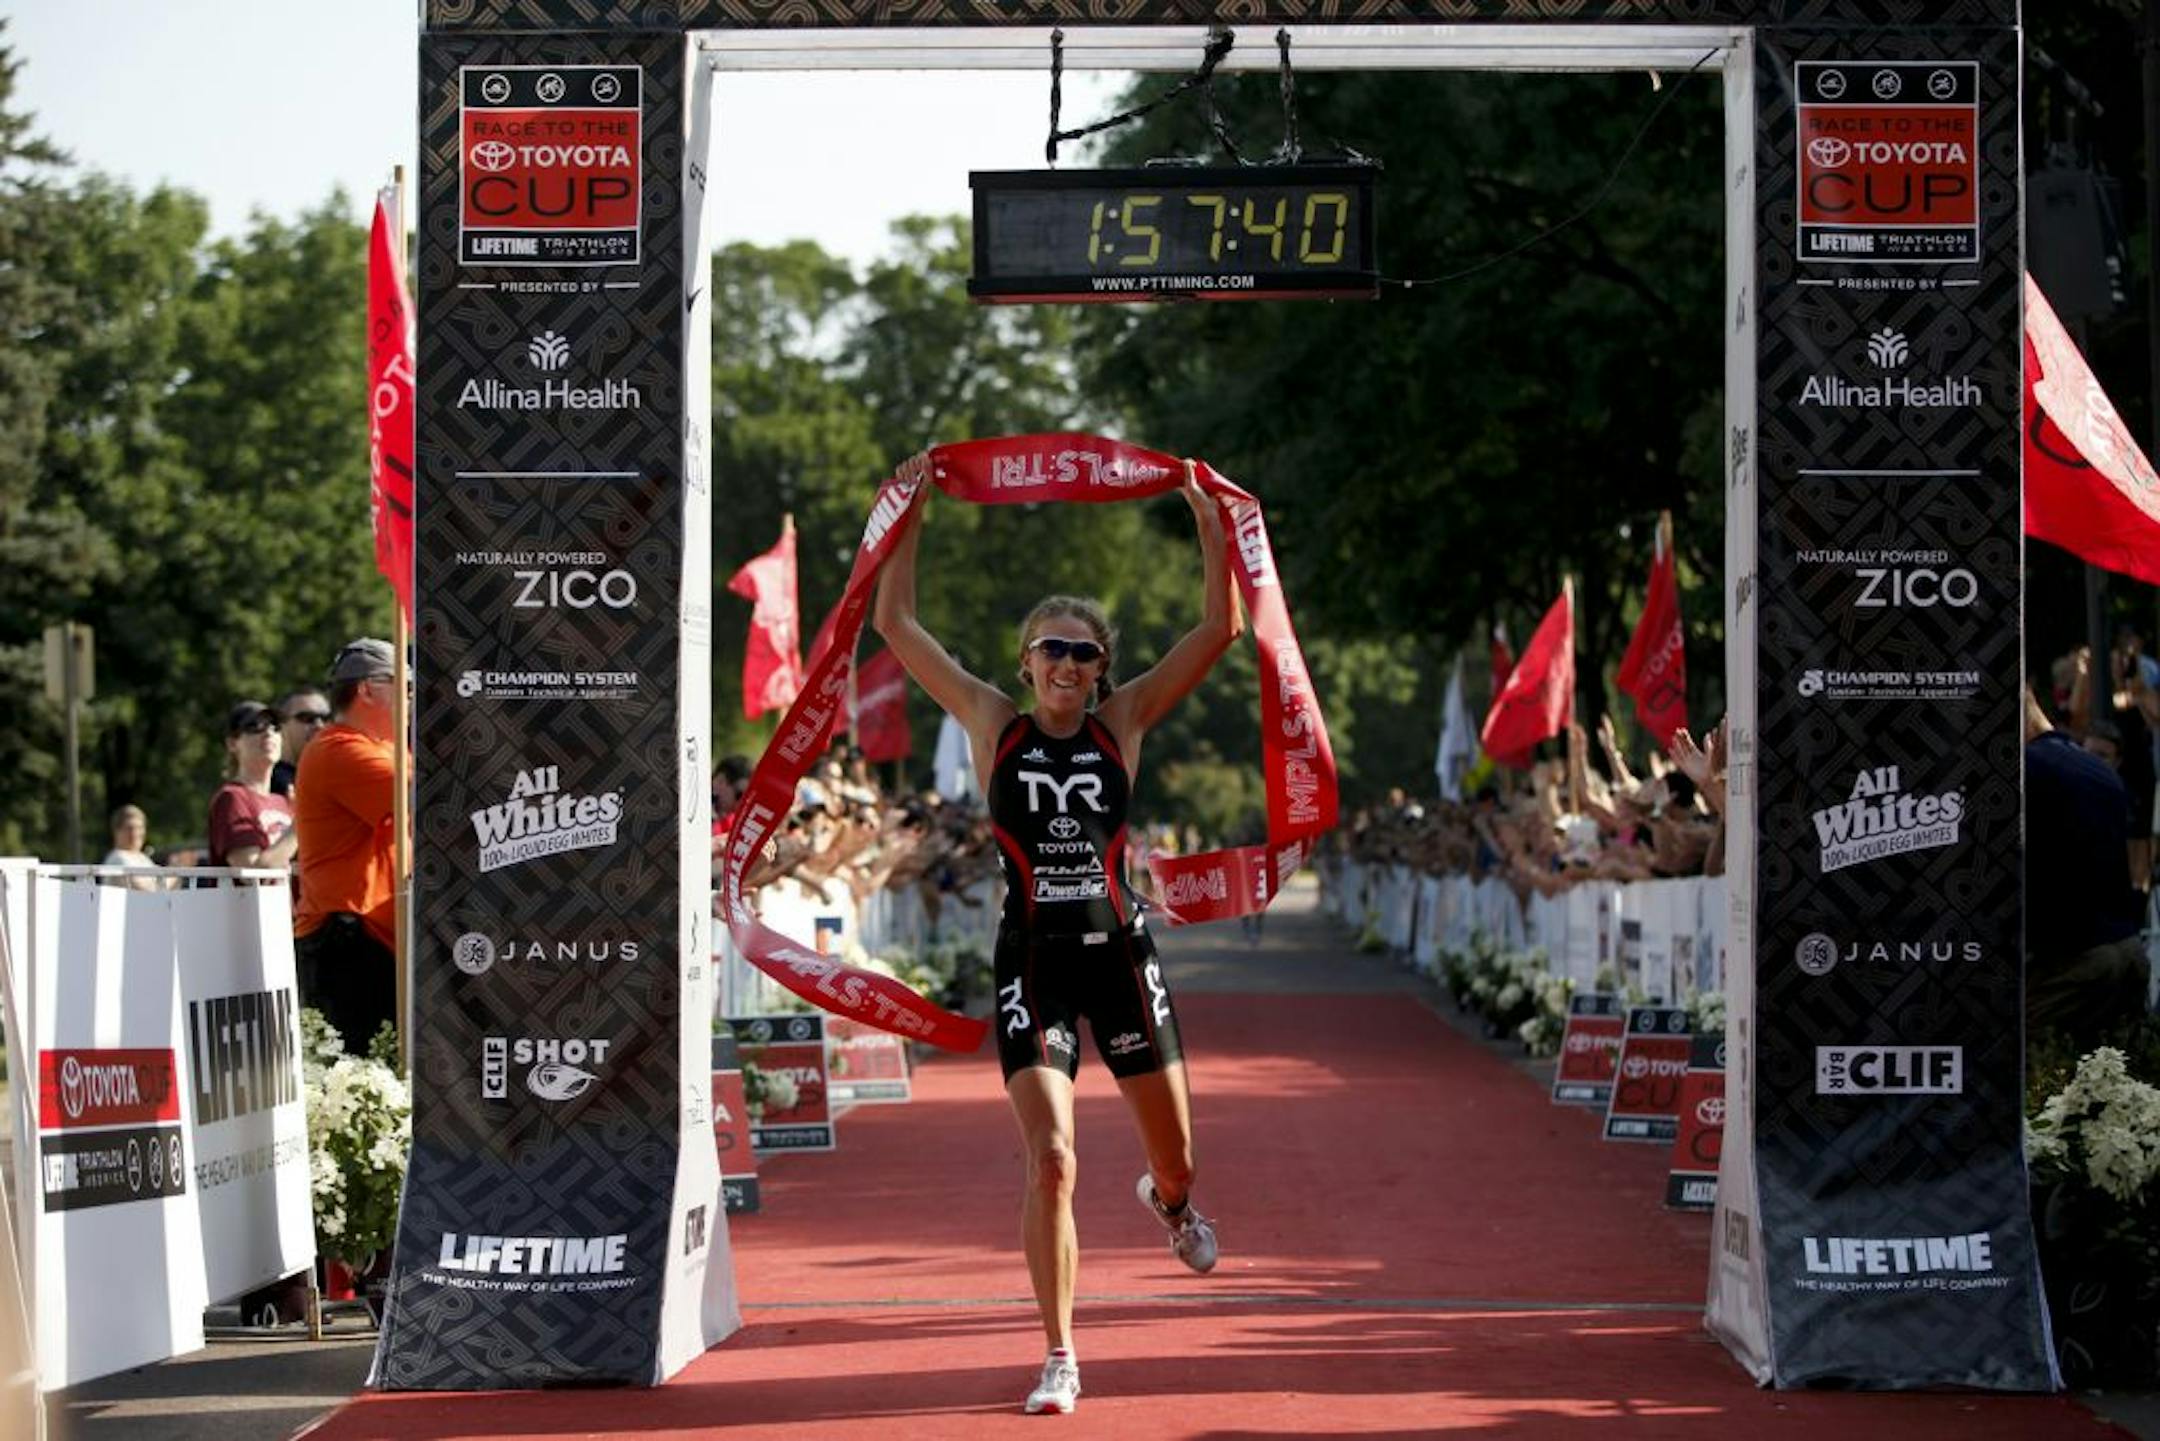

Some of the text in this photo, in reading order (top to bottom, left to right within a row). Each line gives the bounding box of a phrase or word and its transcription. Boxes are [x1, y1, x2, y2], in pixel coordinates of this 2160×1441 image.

[473, 120, 630, 136] RACE TO THE
[1809, 118, 1967, 132] RACE TO THE
[518, 145, 631, 168] TOYOTA
[1854, 142, 1967, 164] TOYOTA
[471, 176, 631, 218] CUP
[1808, 173, 1968, 214] CUP
[472, 237, 629, 255] LIFETIME TRIATHLON
[1810, 233, 1968, 252] LIFETIME TRIATHLON
[500, 282, 599, 292] PRESENTED BY
[1092, 275, 1254, 290] WWW.PTTIMING.COM
[1838, 278, 1938, 290] PRESENTED BY
[457, 378, 640, 409] Allina Health
[1799, 375, 1982, 407] Allina Health
[456, 552, 606, 565] NATURALLY POWERED
[1797, 551, 1948, 564] NATURALLY POWERED
[513, 569, 637, 609] ZICO
[1854, 568, 1979, 608] ZICO
[485, 671, 638, 685] CHAMPION SYSTEM
[1827, 671, 1979, 685] CHAMPION SYSTEM
[508, 764, 560, 800] All
[1018, 770, 1103, 813] TYR
[1849, 765, 1899, 800] All
[471, 792, 621, 848] Whites
[1813, 792, 1961, 849] Whites
[511, 839, 547, 862] LIQUID
[548, 832, 570, 851] EGG
[571, 826, 610, 845] WHITES
[1037, 843, 1096, 854] TOYOTA
[1853, 839, 1887, 861] LIQUID
[1889, 834, 1912, 850] EGG
[1912, 827, 1951, 847] WHITES
[1037, 880, 1105, 897] PowerBar
[500, 940, 640, 961] JANUS
[1844, 942, 1983, 962] JANUS
[190, 987, 299, 1126] LIFETIME
[513, 1039, 611, 1065] SHOT
[485, 1042, 504, 1092] CLIF
[1829, 1053, 1845, 1089] BAR
[1849, 1052, 1954, 1088] CLIF
[82, 1064, 140, 1106] TOYOTA
[438, 1231, 628, 1275] LIFETIME
[1803, 1231, 1993, 1274] LIFETIME
[421, 1272, 636, 1292] THE HEALTHY WAY OF LIFE COMPANY
[1795, 1277, 2010, 1292] THE HEALTHY WAY OF LIFE COMPANY
